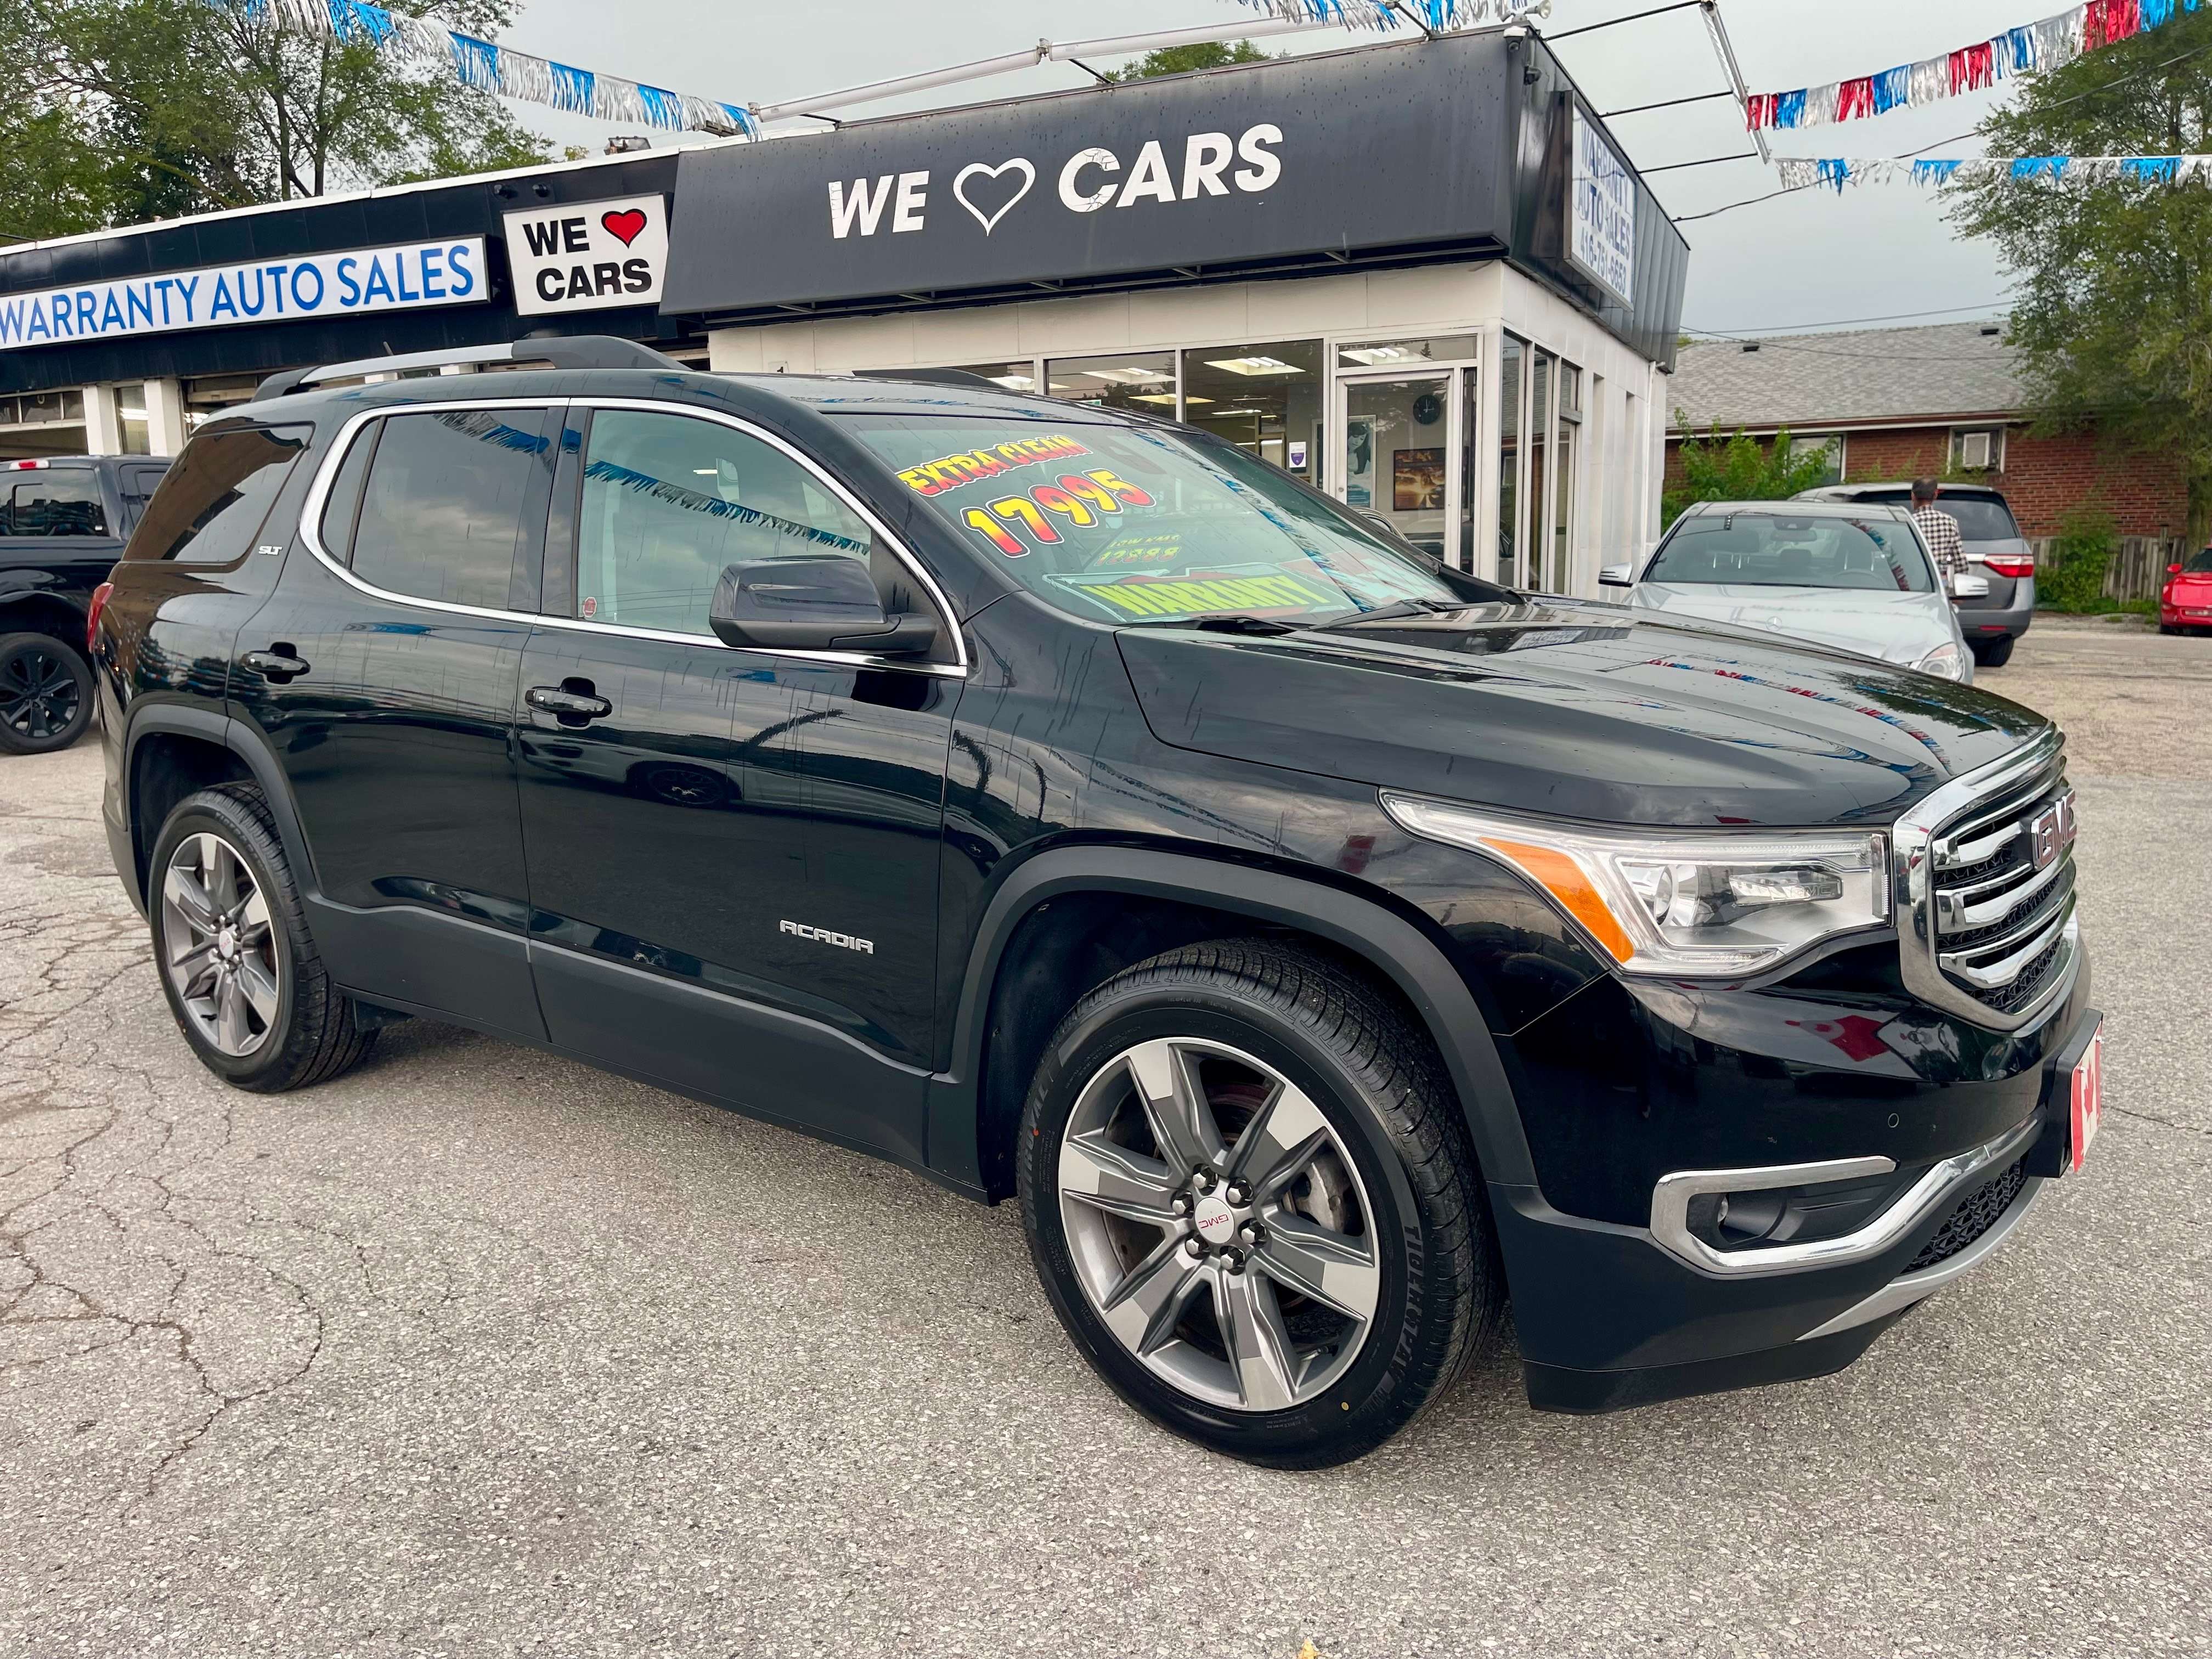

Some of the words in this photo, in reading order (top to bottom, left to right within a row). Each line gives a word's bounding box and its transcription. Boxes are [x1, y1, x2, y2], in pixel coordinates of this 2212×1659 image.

[828, 170, 929, 239] WE
[1058, 123, 1283, 213] CARS
[1582, 117, 1629, 213] WARRANTY
[522, 217, 590, 257] WE
[1578, 171, 1604, 233] AUTO
[1605, 198, 1630, 261] SALES
[0, 276, 199, 344] WARRANTY
[210, 262, 324, 320] AUTO
[337, 245, 474, 306] SALES
[536, 258, 652, 301] CARS
[896, 449, 1012, 495] EXTRA
[997, 435, 1092, 465] CLEAN
[963, 469, 1153, 556] 17995
[258, 545, 283, 555] SLT
[1079, 575, 1330, 615] WARRANTY
[2031, 788, 2077, 871] GMC
[780, 919, 873, 955] ACADIA
[1198, 1214, 1229, 1229] GMC
